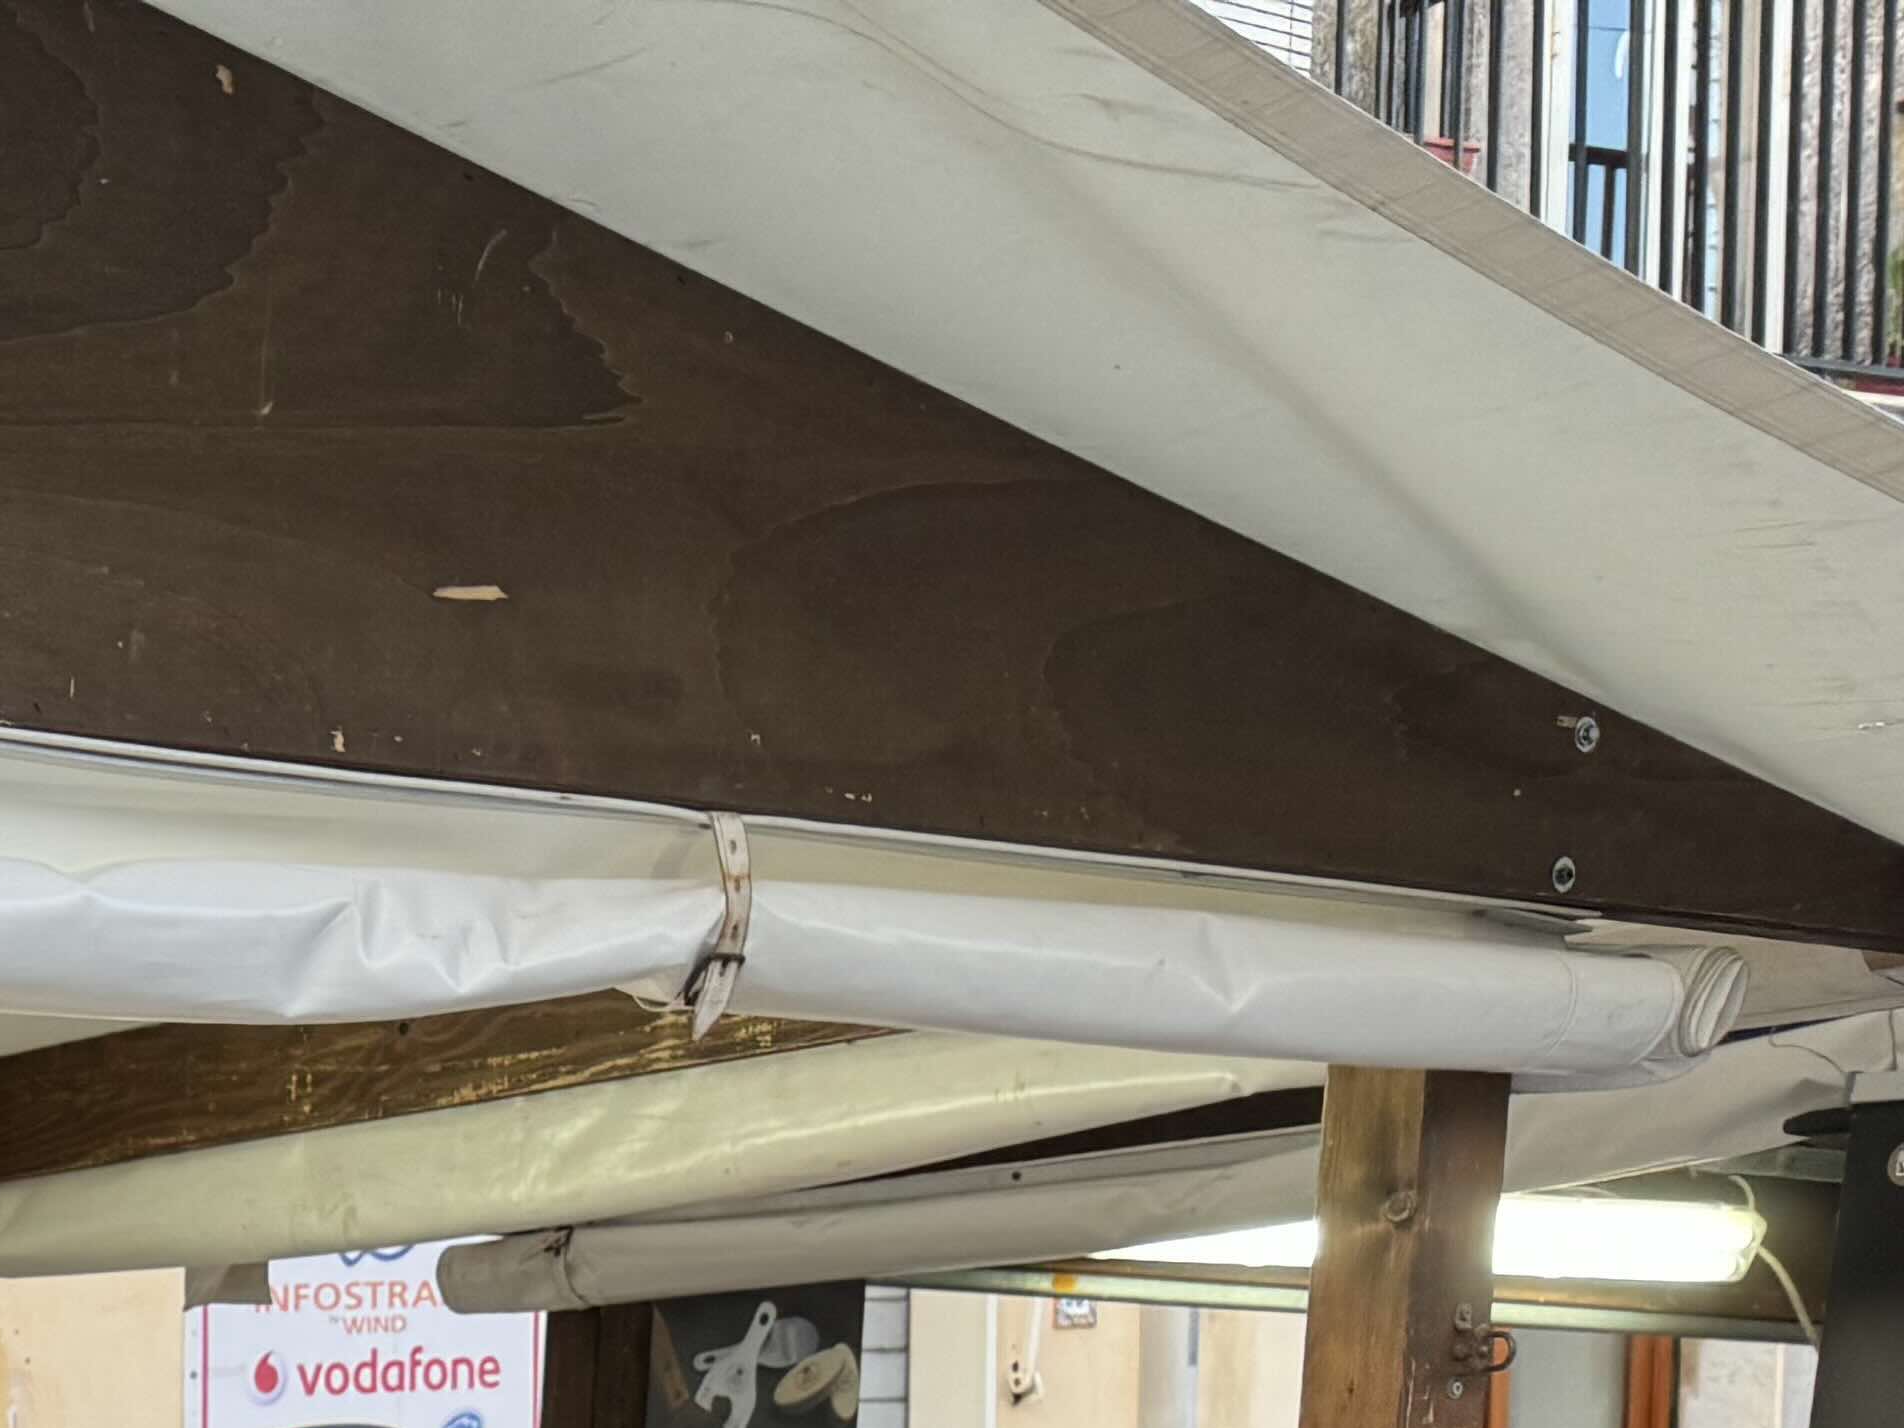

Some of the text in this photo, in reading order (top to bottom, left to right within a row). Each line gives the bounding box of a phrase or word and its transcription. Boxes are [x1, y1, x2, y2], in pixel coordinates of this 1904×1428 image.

[255, 1280, 444, 1314] NFOSTRA
[342, 1315, 407, 1335] WIND
[297, 1345, 501, 1397] vodafone
